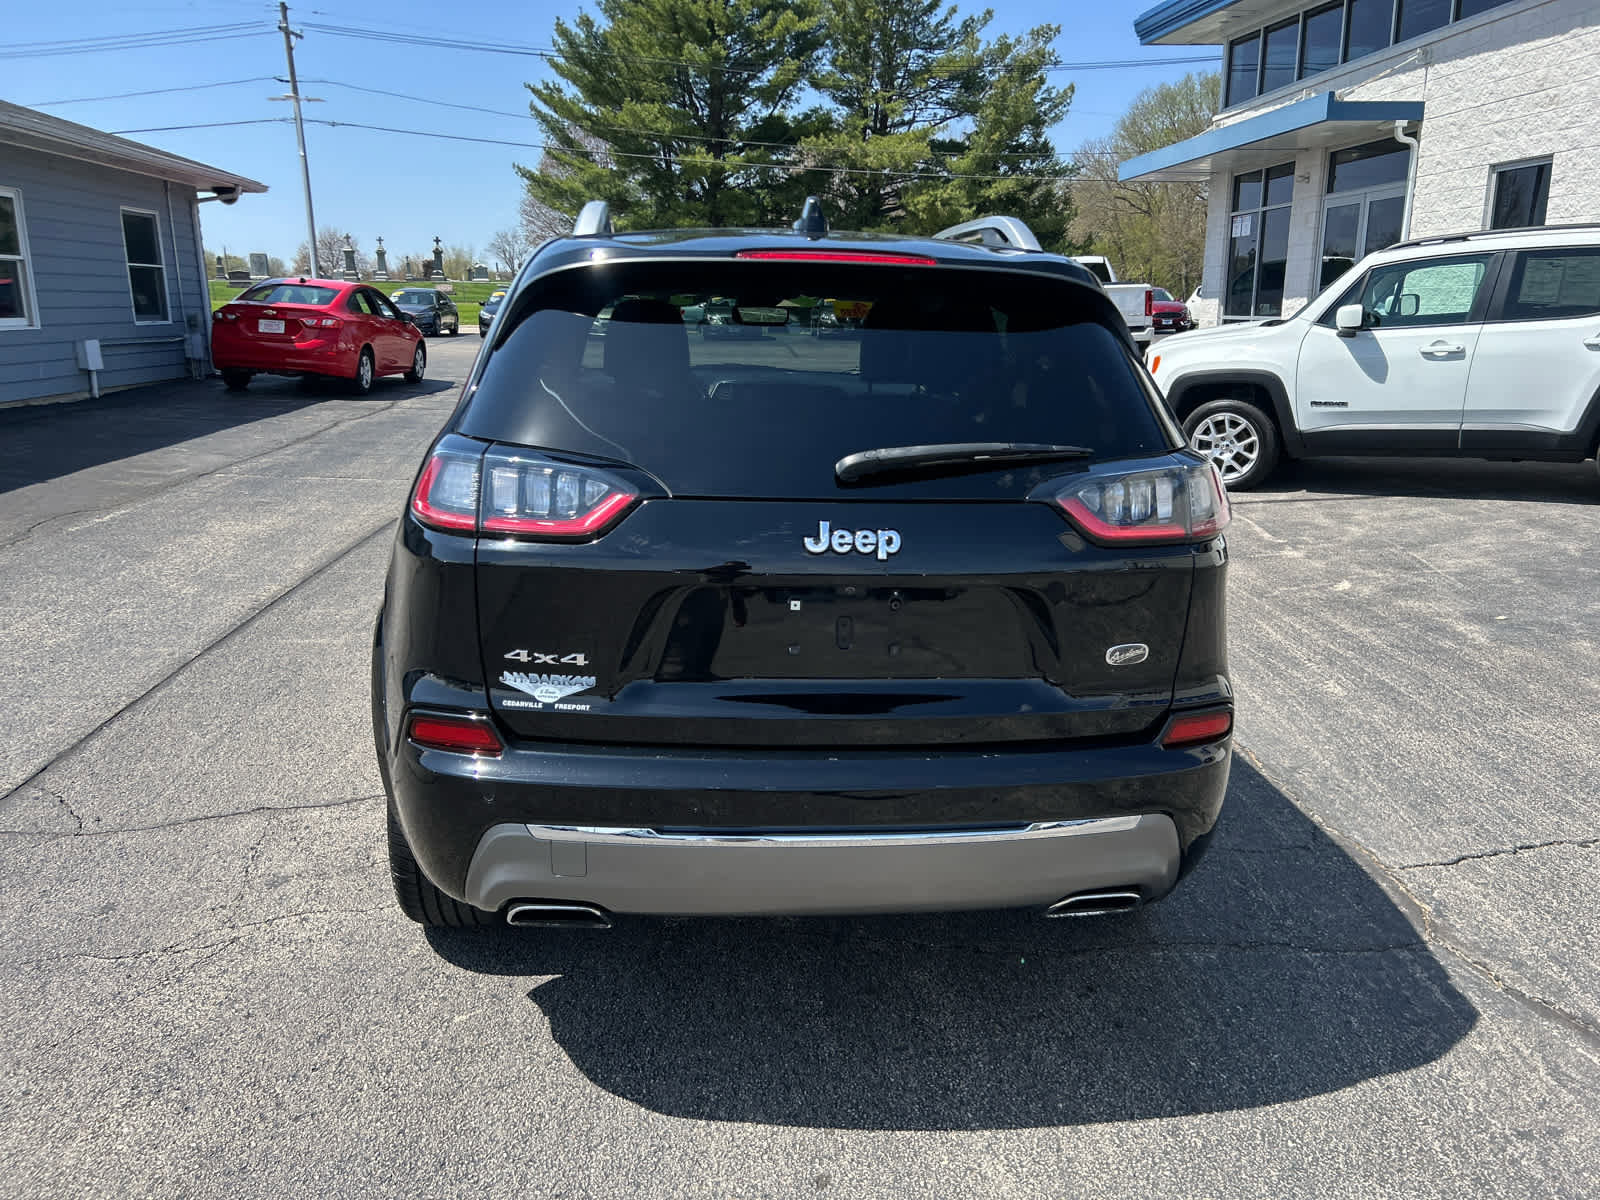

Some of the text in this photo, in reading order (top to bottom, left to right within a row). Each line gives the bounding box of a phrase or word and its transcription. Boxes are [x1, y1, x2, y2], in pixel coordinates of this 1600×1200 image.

[803, 520, 901, 560] Jeep
[502, 700, 590, 711] CEDARVILLE FREEPORT
